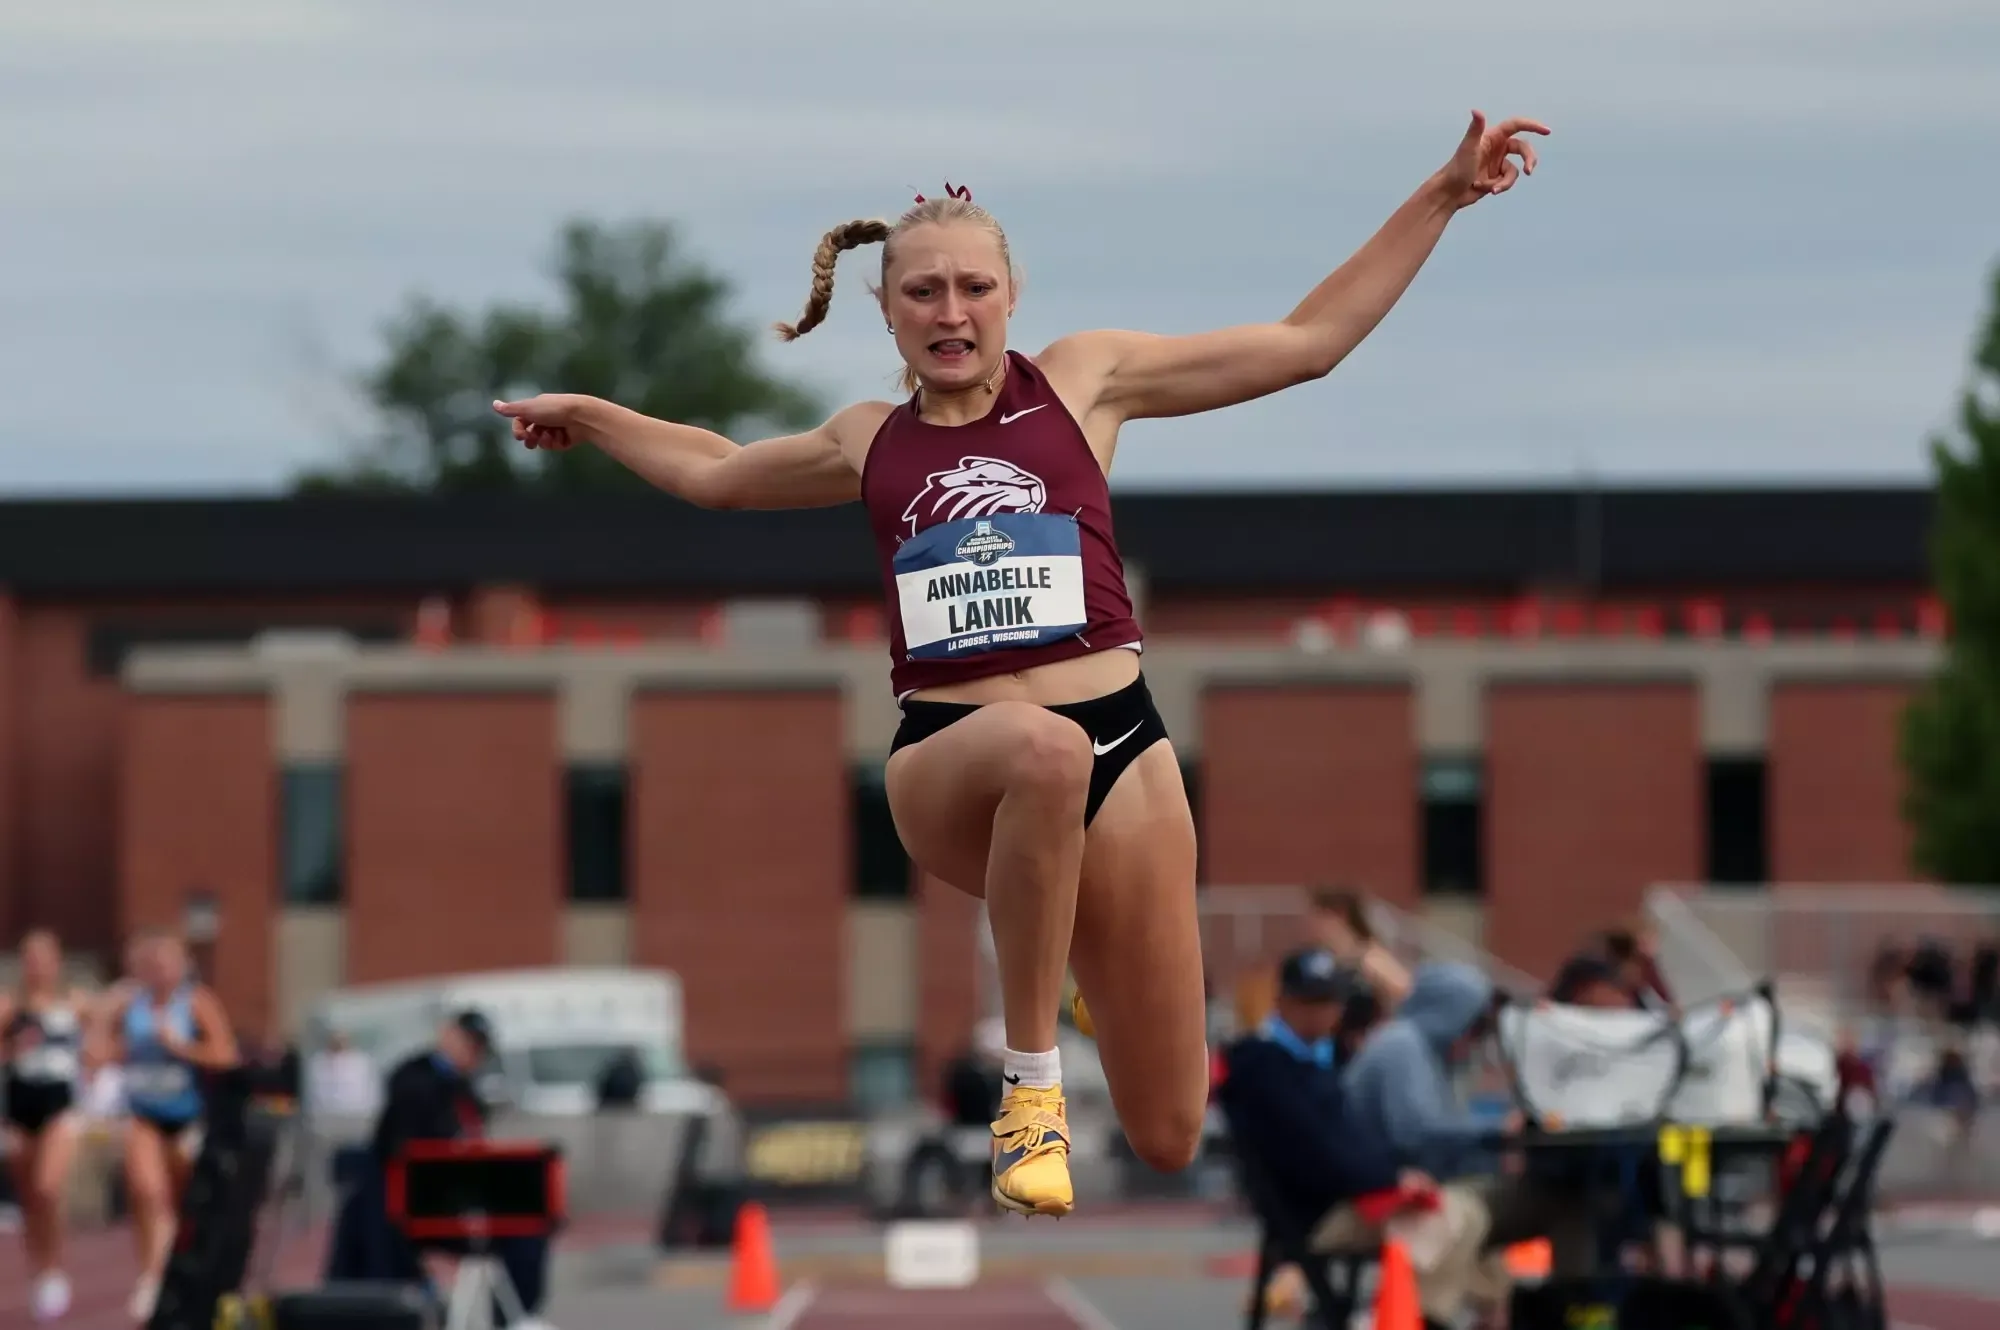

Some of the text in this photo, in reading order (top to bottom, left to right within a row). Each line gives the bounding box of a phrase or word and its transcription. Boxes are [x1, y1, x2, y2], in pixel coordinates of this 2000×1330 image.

[958, 542, 1013, 555] CHAMPIONSHIPS
[927, 567, 1051, 602] ANNABELLE
[949, 596, 1034, 634] LANIK
[948, 630, 1039, 651] LA CROSSE, WISCONSIN
